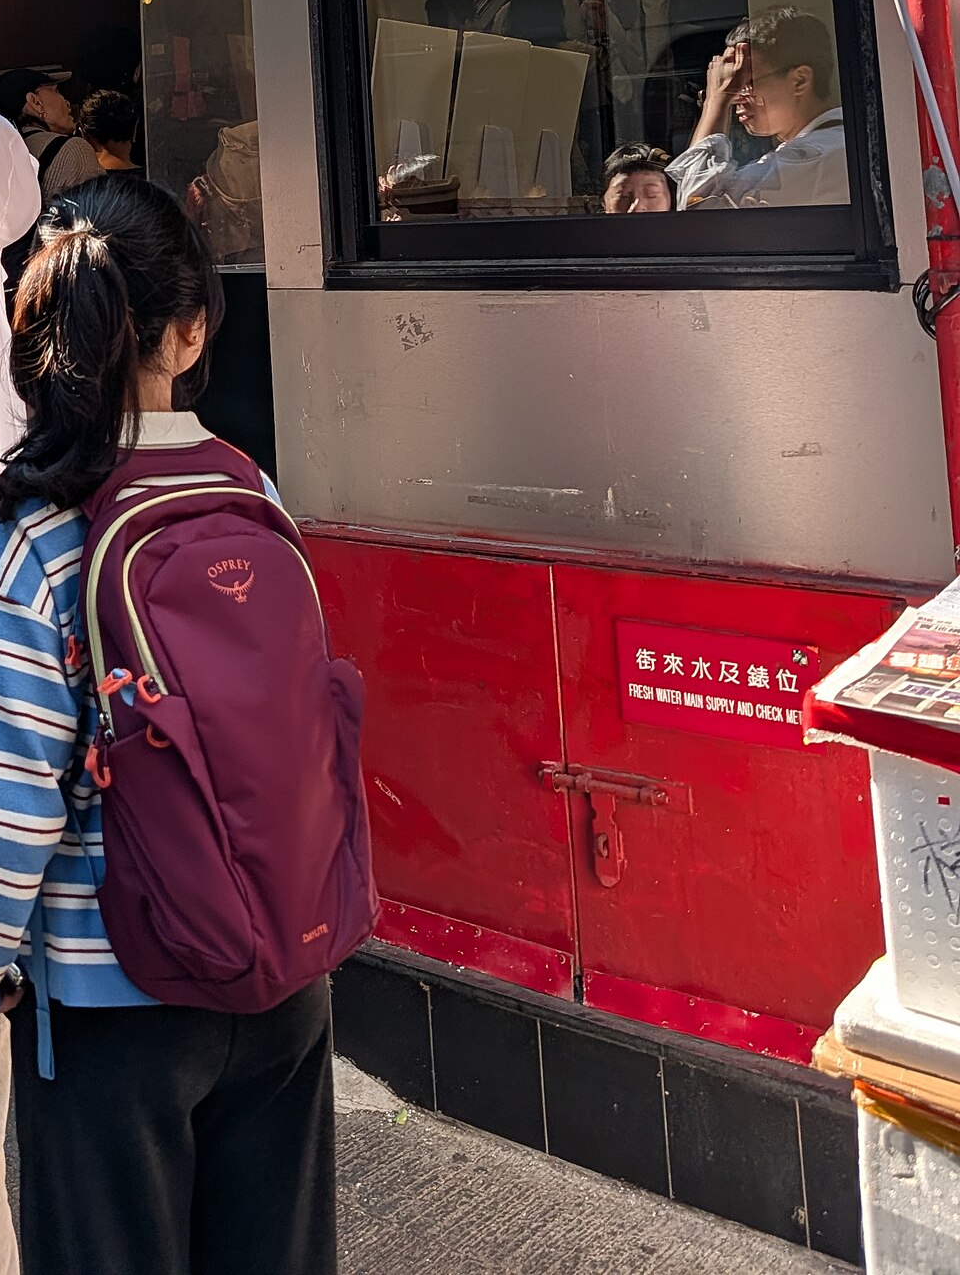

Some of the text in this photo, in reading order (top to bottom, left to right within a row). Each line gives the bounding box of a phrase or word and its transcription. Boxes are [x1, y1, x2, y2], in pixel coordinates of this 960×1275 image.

[207, 558, 251, 578] OSPREY
[635, 648, 799, 693] 街來水及錶位
[628, 683, 803, 725] FRESH WATER MAIN SUPPLY AND CHECK MET
